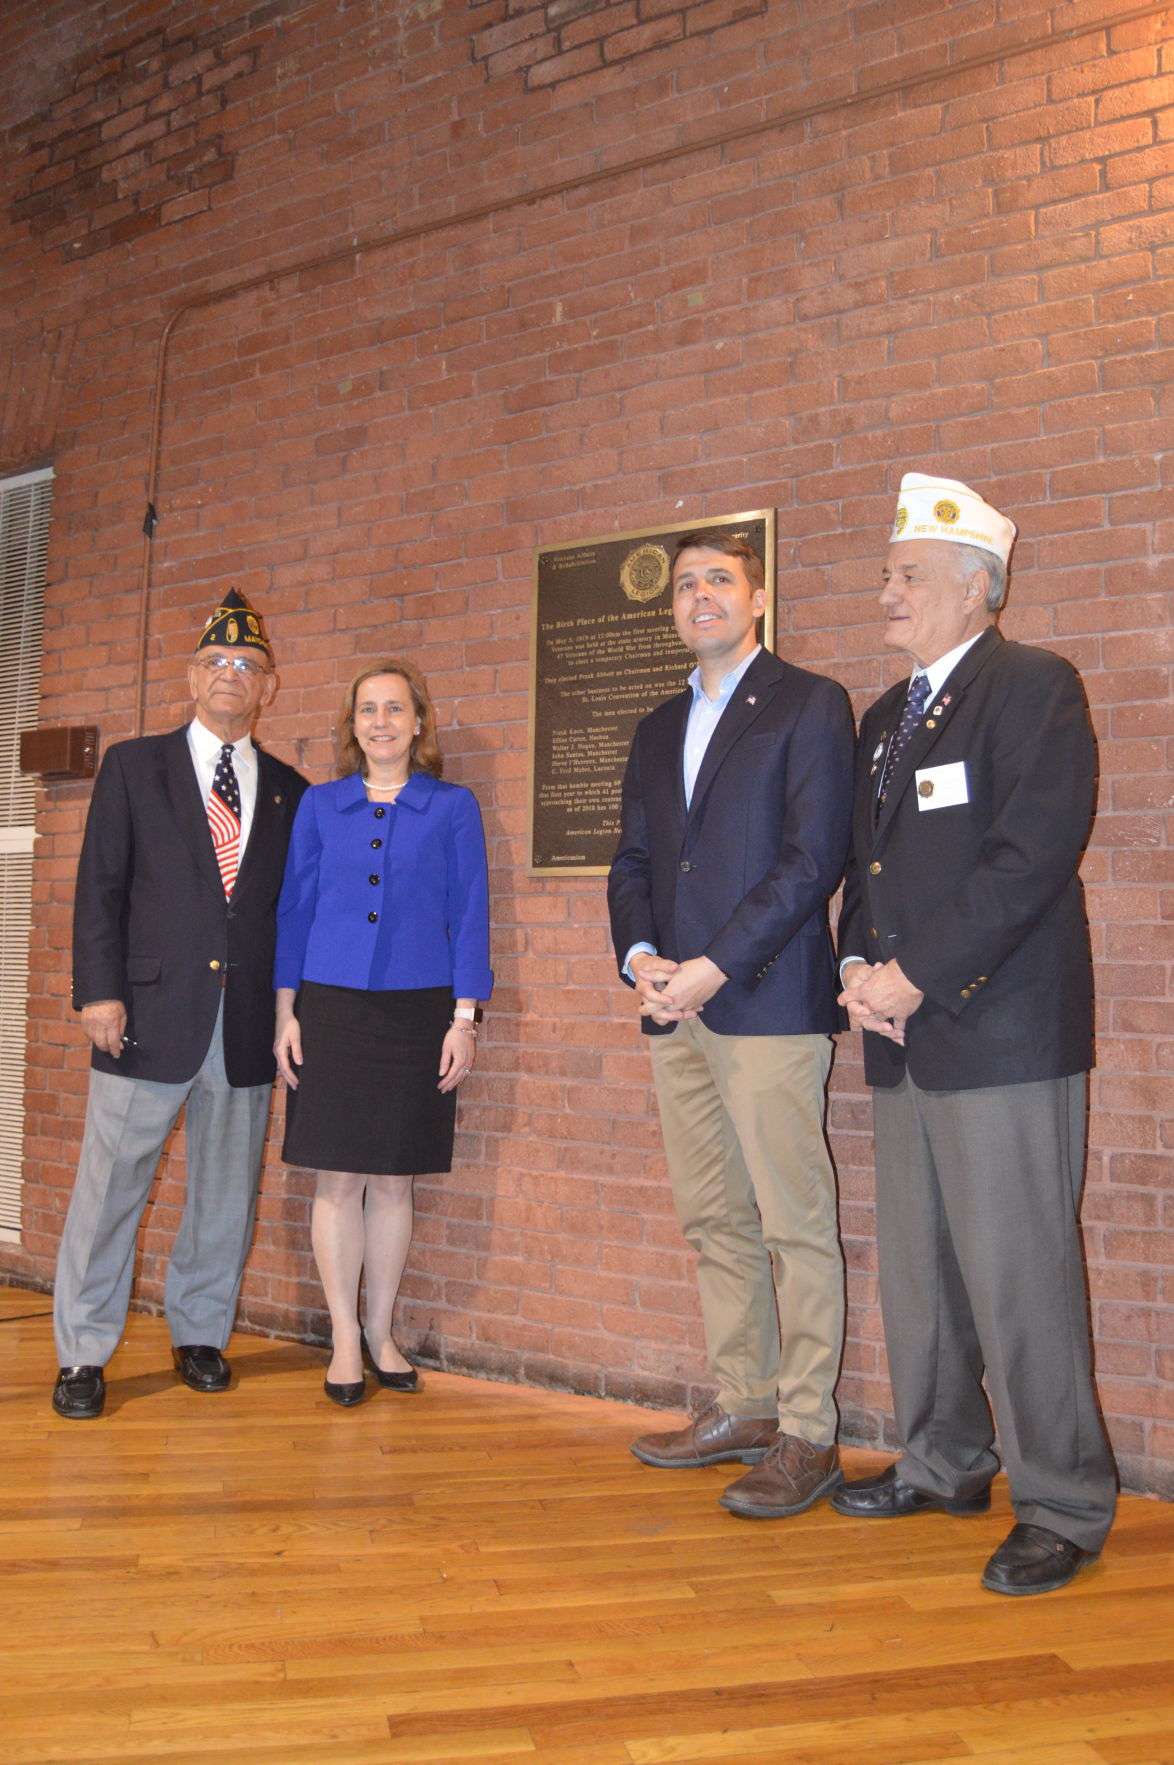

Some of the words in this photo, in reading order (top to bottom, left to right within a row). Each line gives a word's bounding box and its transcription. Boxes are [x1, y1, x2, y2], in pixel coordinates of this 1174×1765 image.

[914, 524, 938, 533] NEW
[941, 527, 993, 544] HAMPSHIRE
[631, 585, 660, 597] LEGION
[541, 622, 554, 631] The
[556, 620, 574, 629] Birth
[577, 617, 596, 626] Place
[598, 615, 605, 623] of
[608, 614, 620, 622] the
[622, 610, 656, 620] American
[659, 608, 673, 617] Leg
[646, 626, 670, 634] meeting
[624, 651, 652, 660] Chairman
[624, 667, 651, 675] Chairman
[664, 662, 687, 671] Richard
[560, 690, 570, 698] The
[608, 692, 640, 700] Convention
[660, 687, 686, 696] America
[617, 708, 636, 716] elected
[587, 726, 618, 734] Manchester
[599, 740, 630, 748] Manchester
[587, 749, 618, 757] Manchester
[600, 756, 628, 764] Mancheste
[584, 788, 600, 796] which
[566, 828, 591, 836] American
[593, 828, 612, 836] Legion
